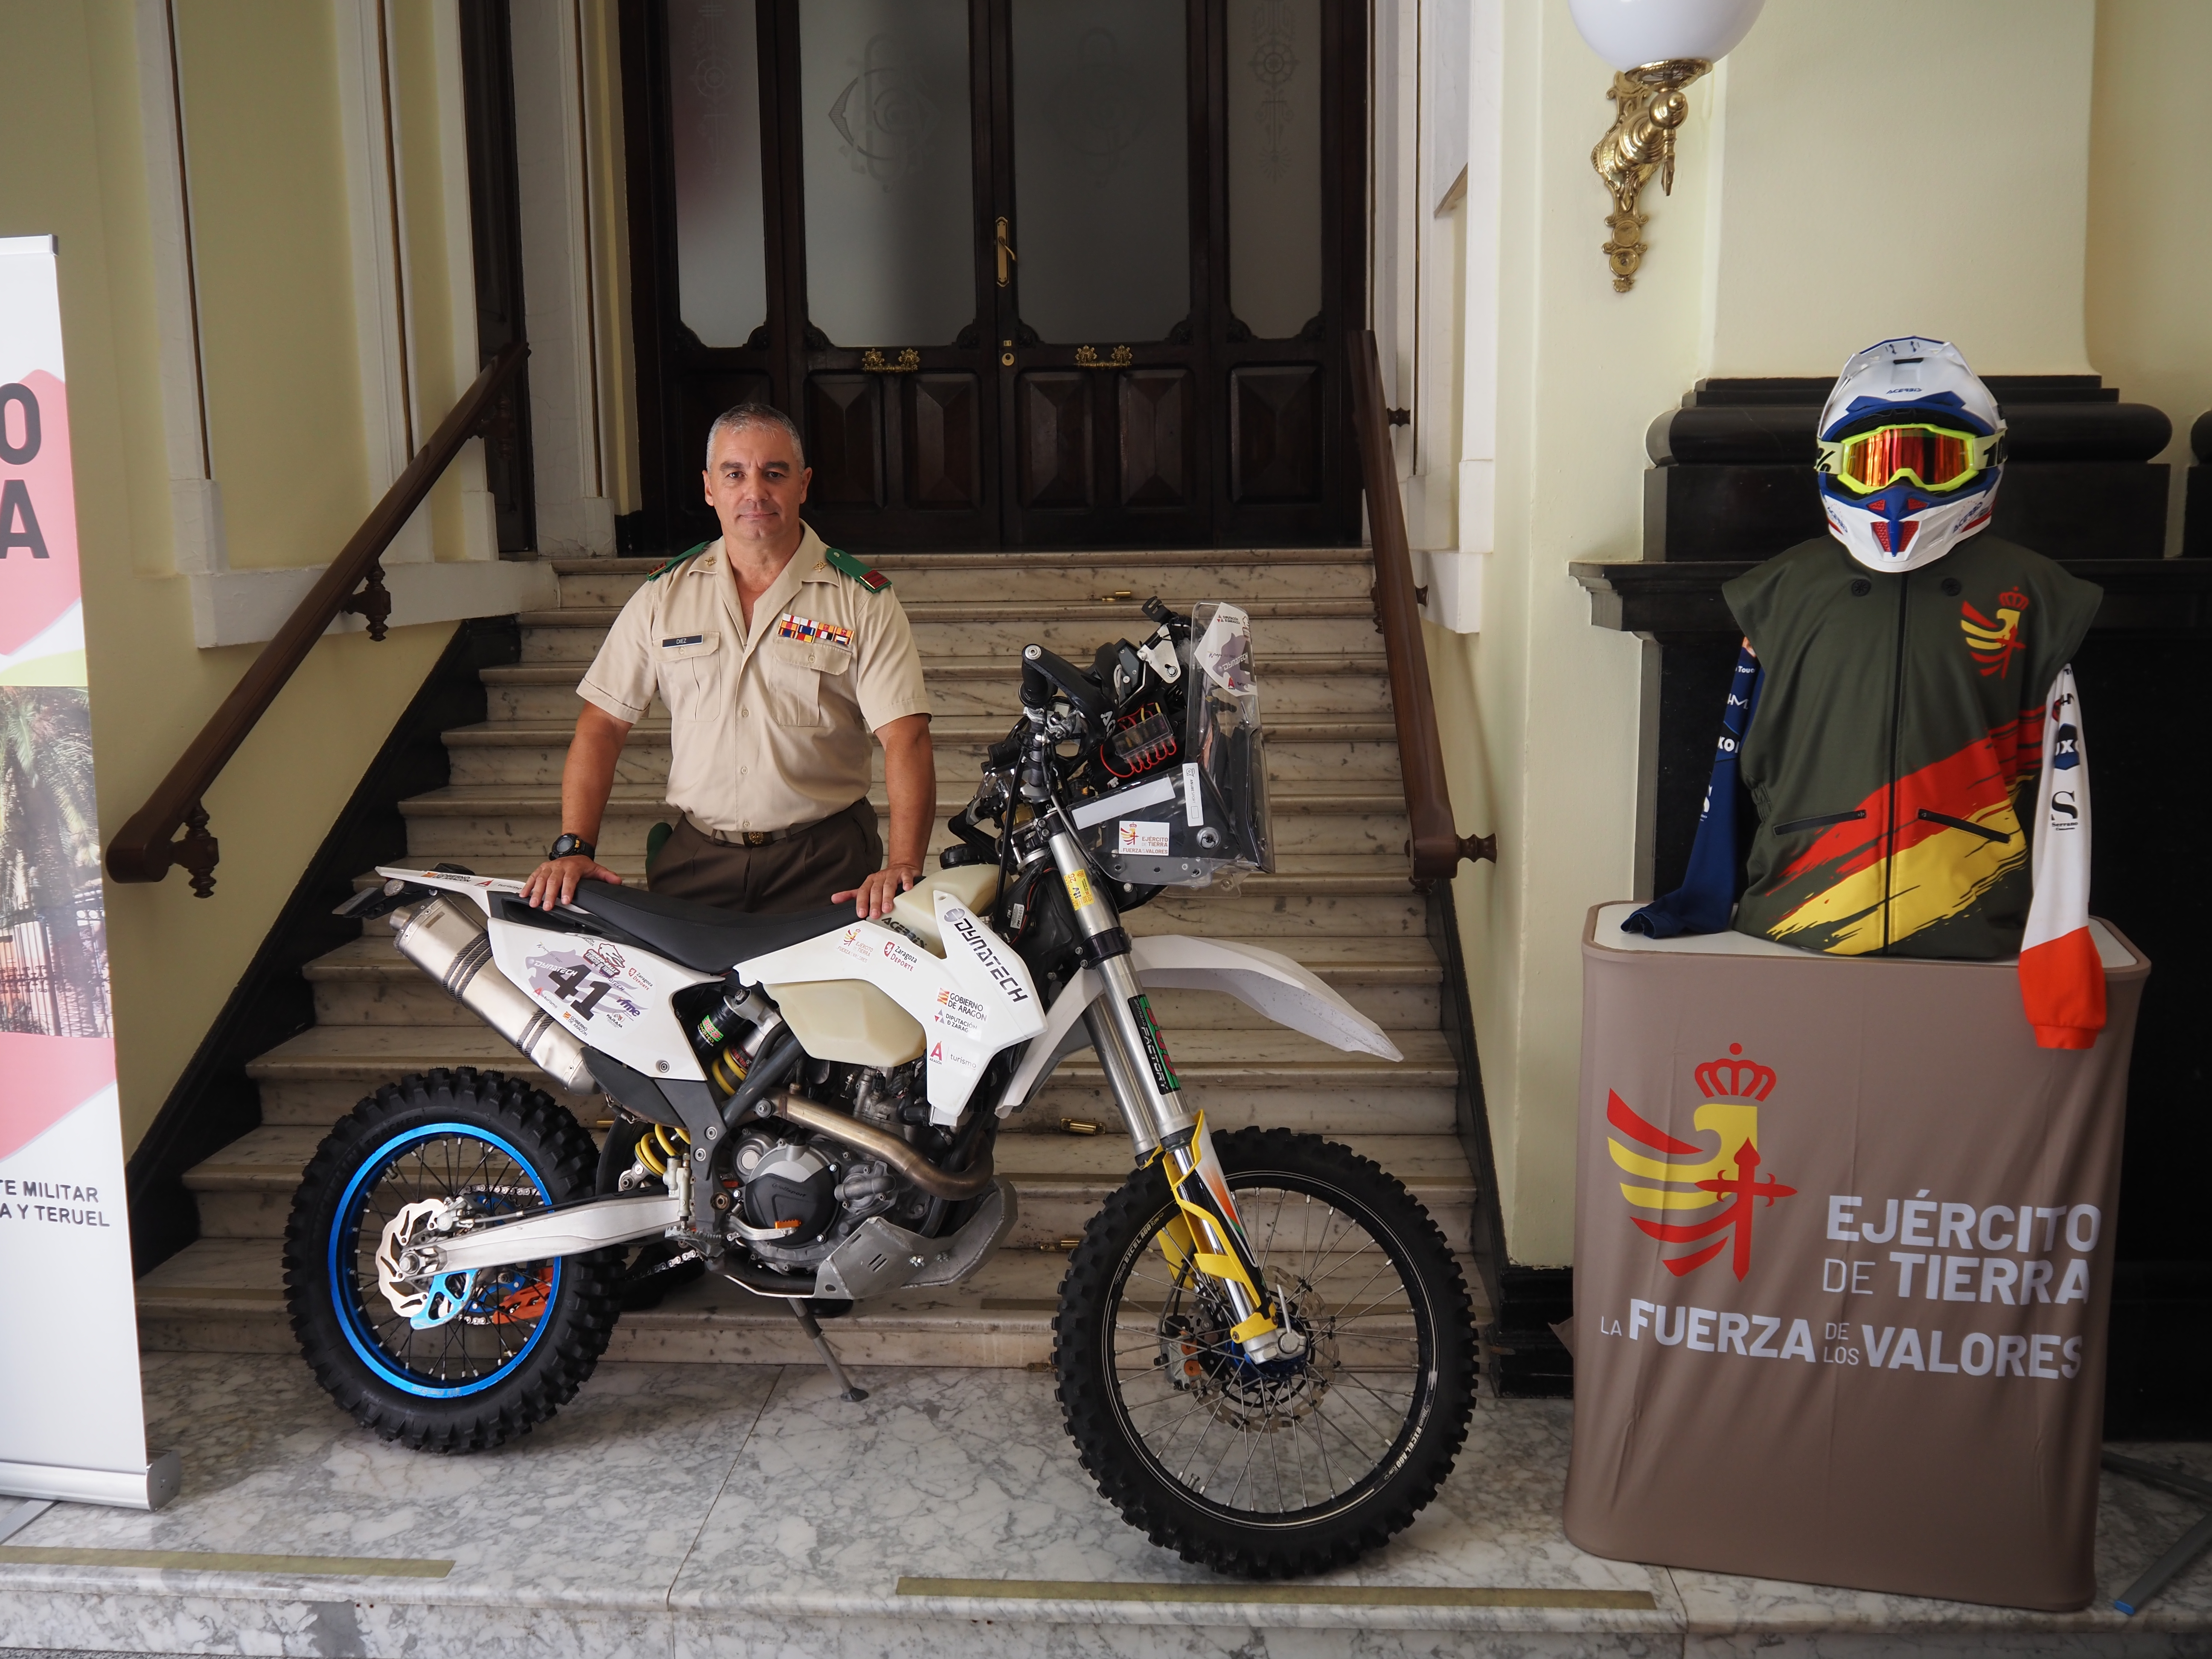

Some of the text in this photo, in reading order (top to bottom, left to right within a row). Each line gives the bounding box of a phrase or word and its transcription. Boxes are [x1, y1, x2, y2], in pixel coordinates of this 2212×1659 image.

[0, 383, 41, 465] O
[0, 479, 50, 559] A
[1222, 652, 1248, 671] DYNATECH
[856, 941, 873, 952] EJÉRCITO
[857, 947, 870, 957] TIERRA
[894, 946, 917, 963] Zaragoza
[534, 960, 578, 976] DYNATECH
[954, 918, 1029, 1003] DYNATECH
[636, 972, 653, 987] Zaragoza
[548, 964, 612, 1021] 41
[950, 993, 983, 1012] GOBIERNO
[948, 1000, 957, 1010] DE
[946, 1013, 977, 1029] DIPUTACIÓN
[950, 1054, 976, 1068] turismo
[1141, 1026, 1169, 1091] FACTORY
[23, 1181, 99, 1203] MILITAR
[17, 1203, 29, 1220] Y
[34, 1205, 110, 1227] TERUEL
[1827, 1189, 2101, 1252] EJÉRCITO
[1124, 1238, 1142, 1264] EXCEL
[1822, 1252, 2090, 1306] DE TIERRA
[1601, 1298, 2083, 1380] LA FUERZA DE LOS VALORES
[1404, 1426, 1421, 1453] EXCEL
